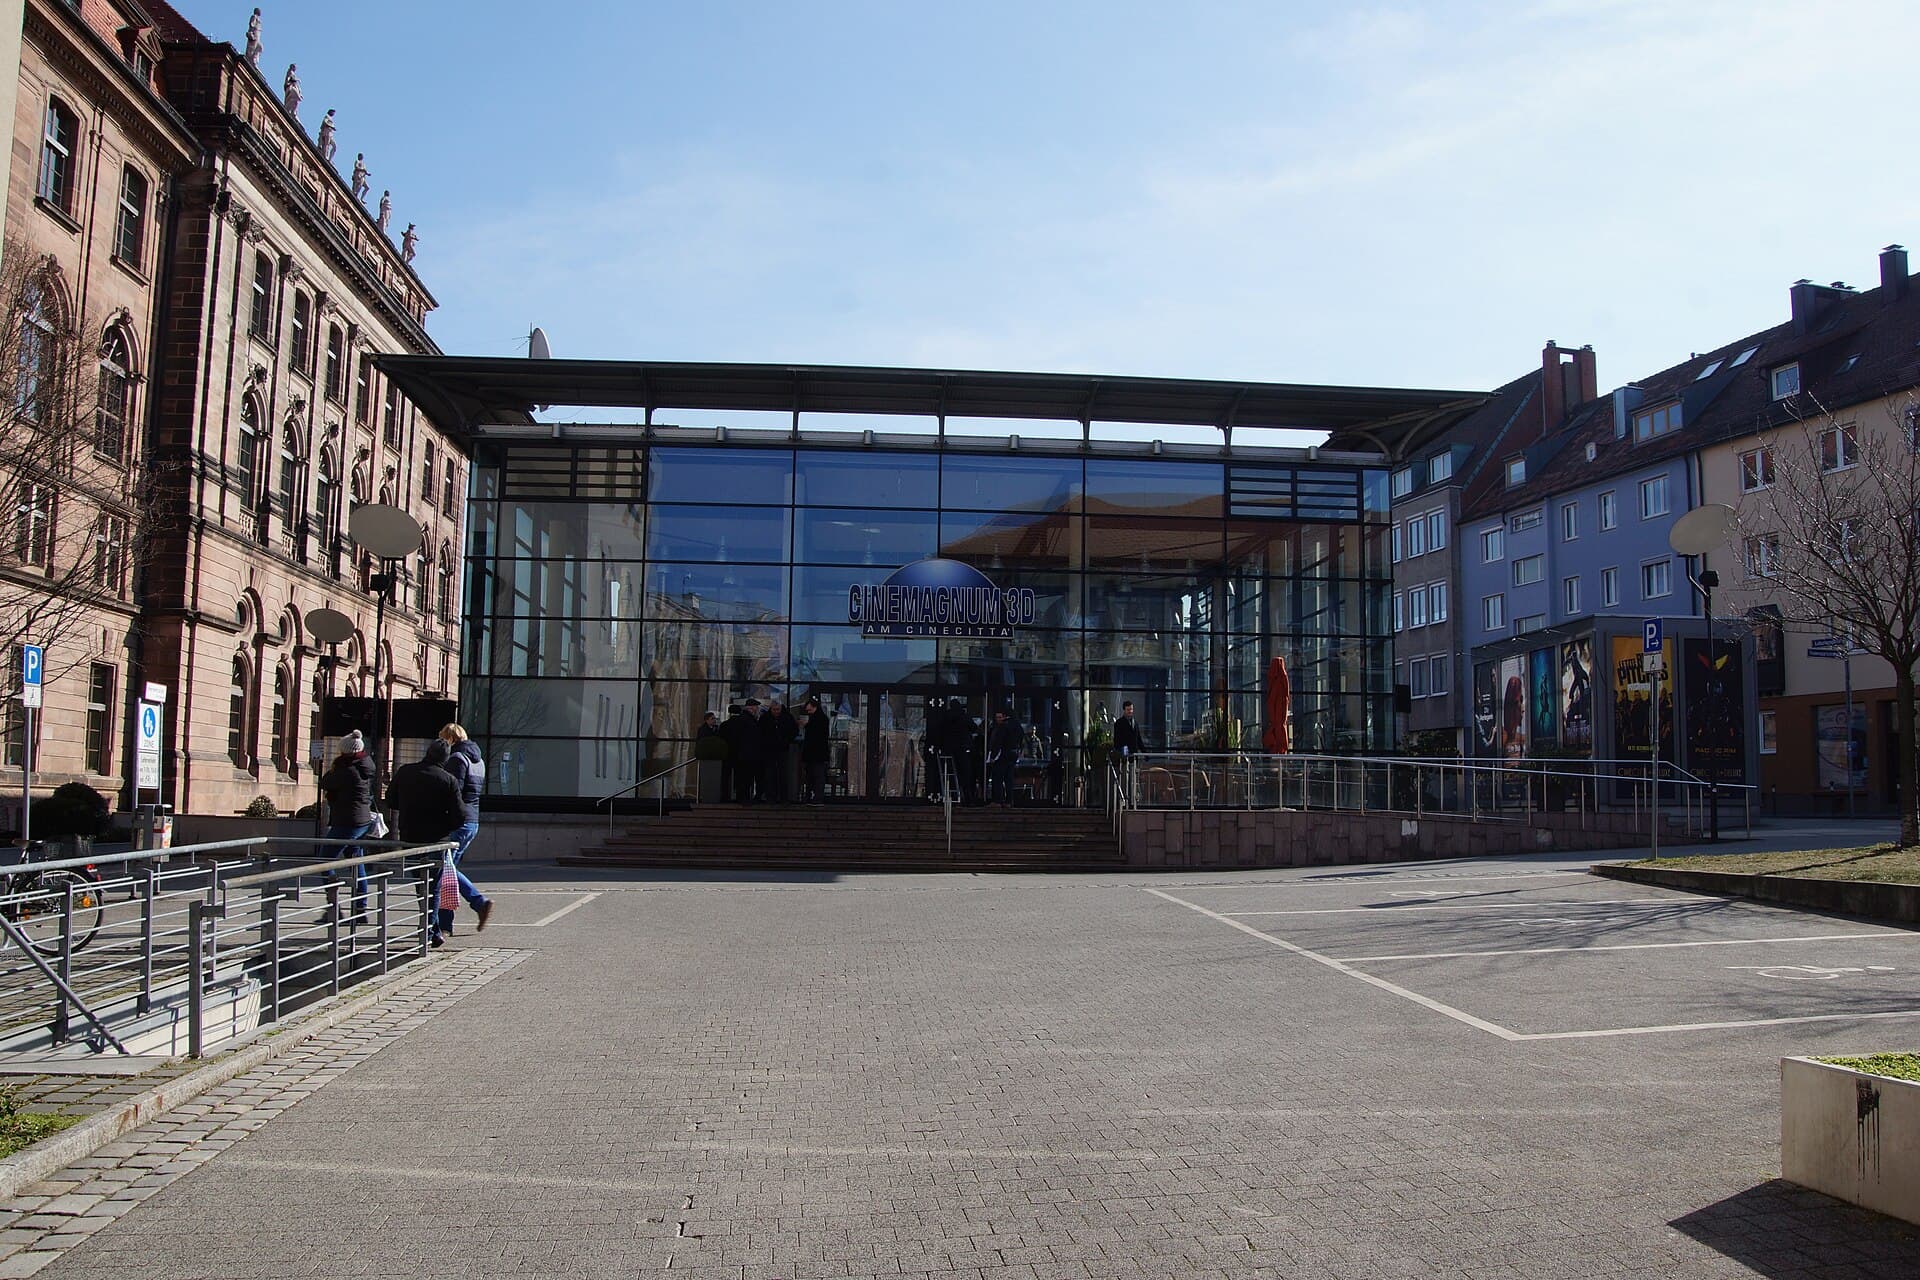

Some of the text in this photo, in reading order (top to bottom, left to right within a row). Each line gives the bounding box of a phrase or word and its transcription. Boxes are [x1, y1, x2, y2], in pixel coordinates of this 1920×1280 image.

[848, 583, 1035, 625] CINEMAGNUM 3D
[867, 625, 890, 634] AM
[1646, 623, 1657, 649] P
[28, 650, 39, 680] P
